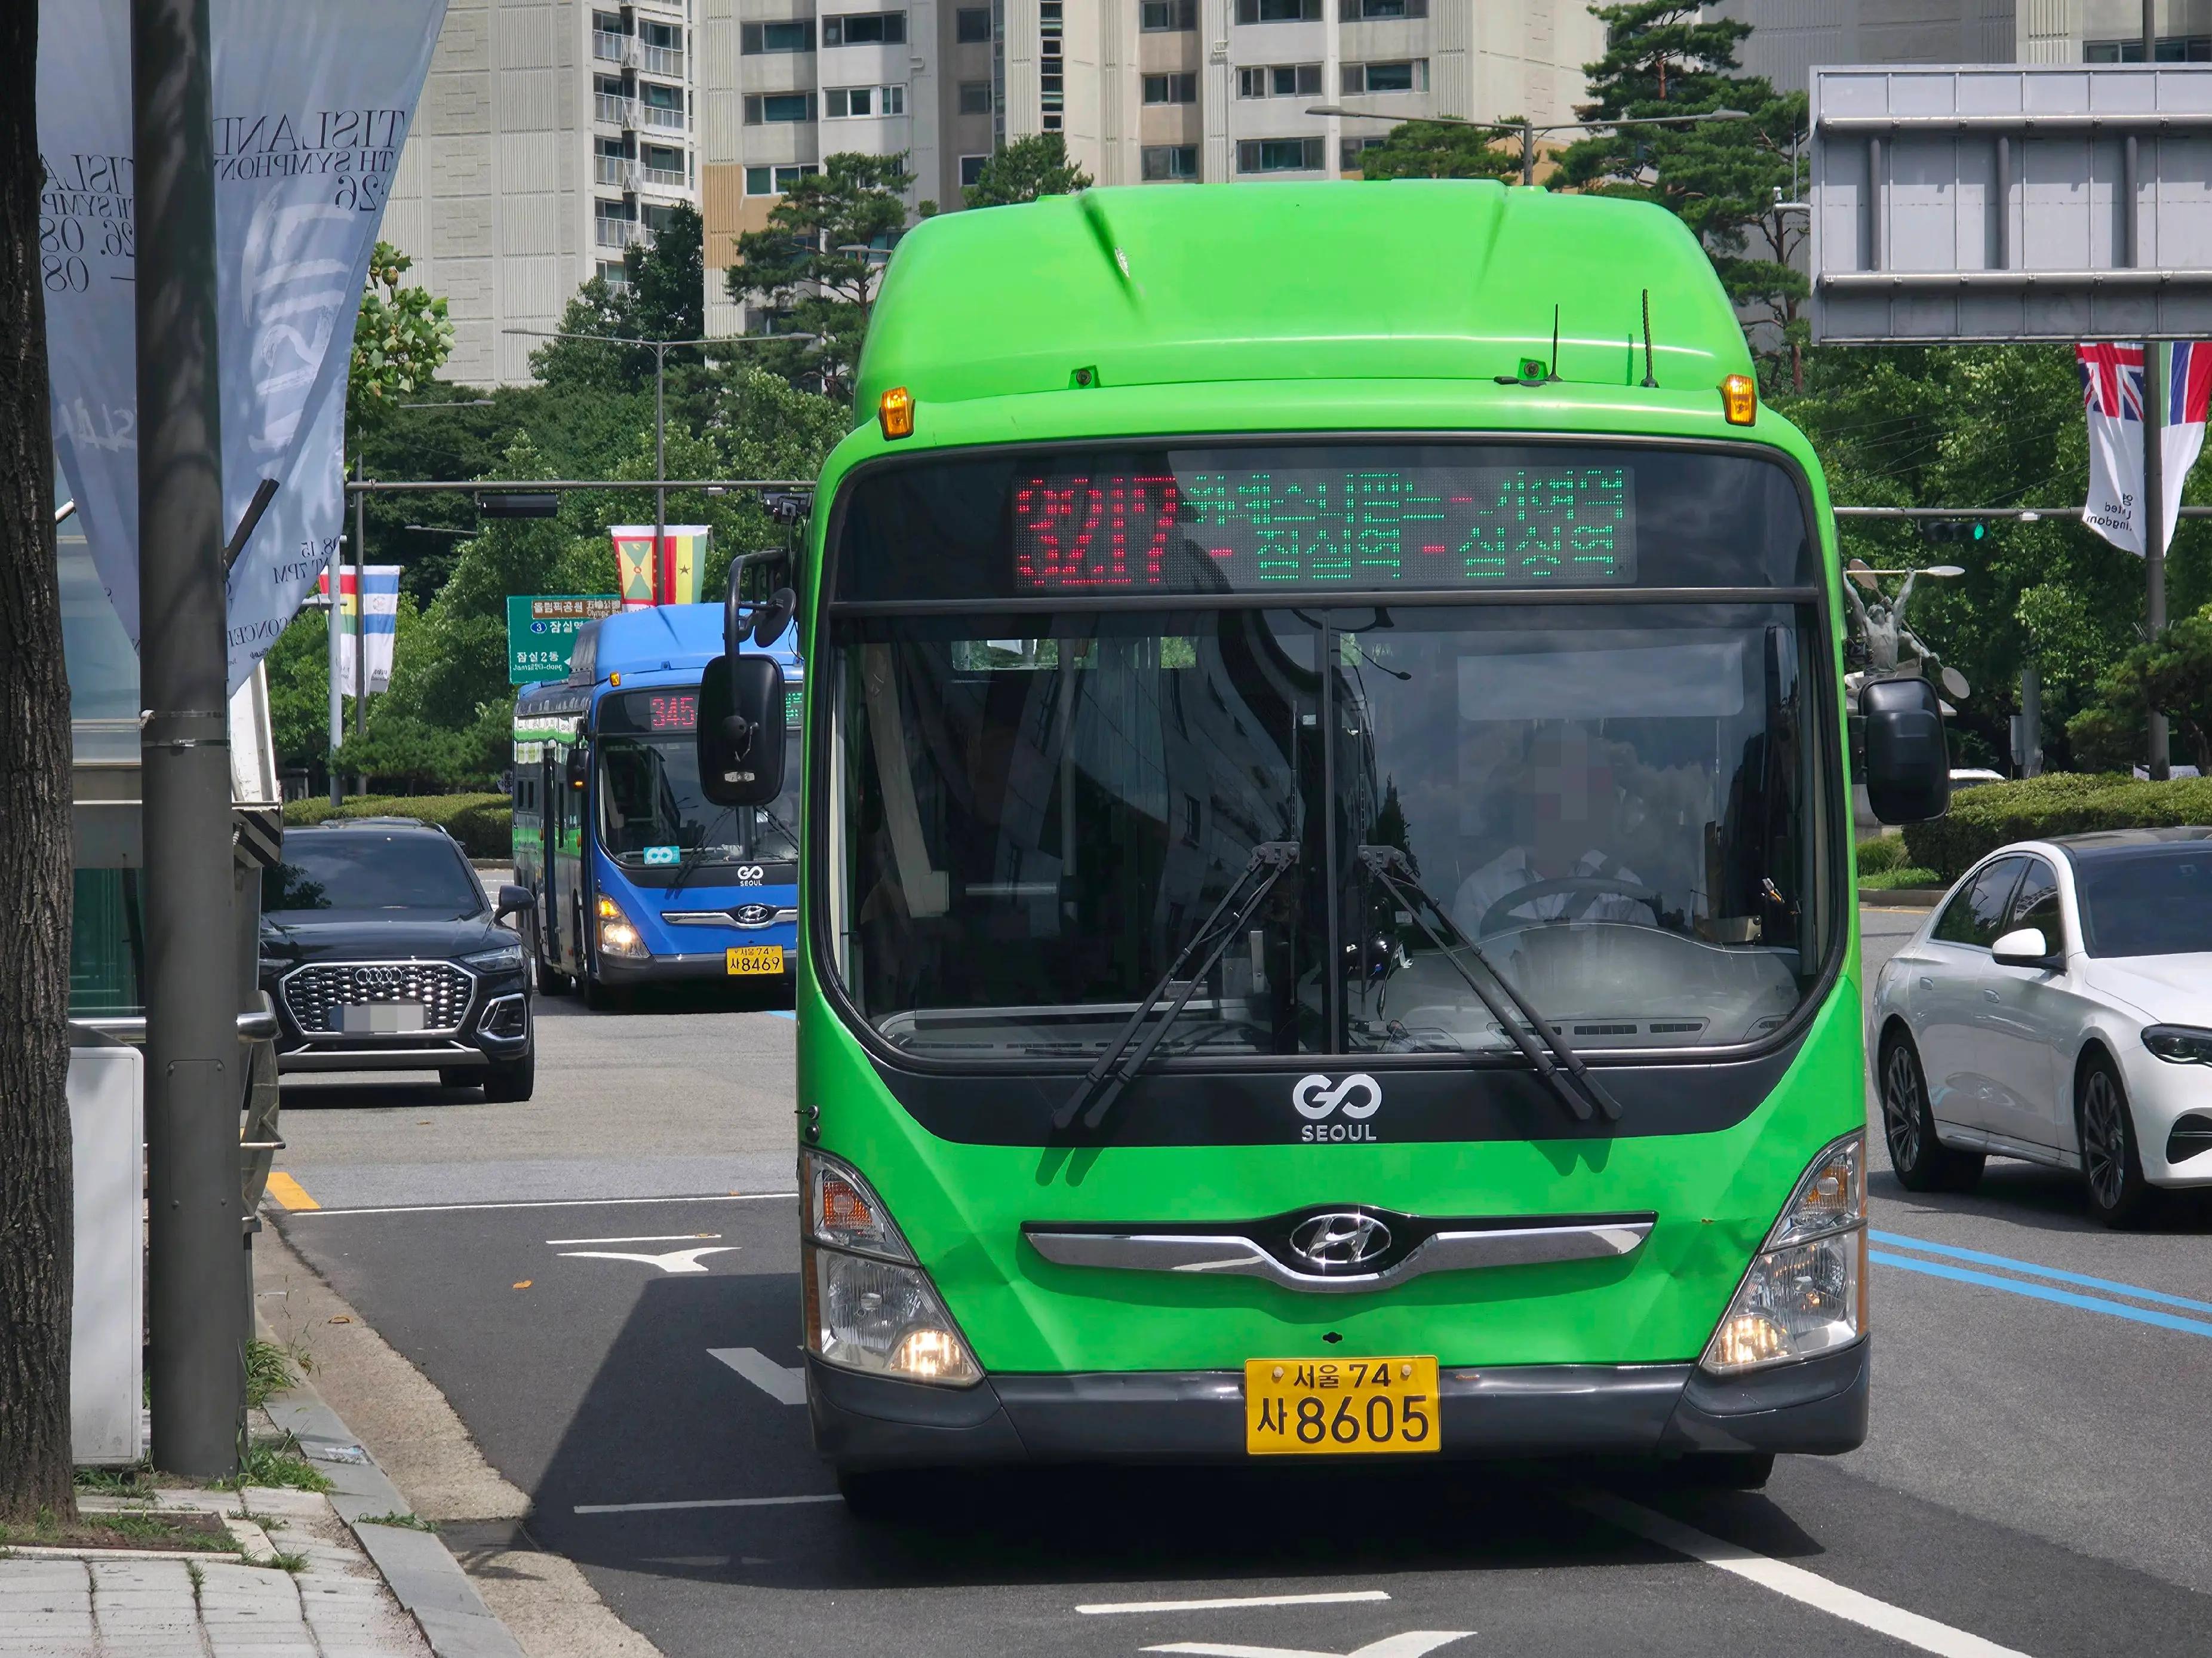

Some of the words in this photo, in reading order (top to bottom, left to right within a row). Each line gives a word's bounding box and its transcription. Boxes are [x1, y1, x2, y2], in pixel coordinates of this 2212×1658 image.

[1256, 528, 1402, 581] 잠실역
[756, 947, 769, 956] 74
[1301, 1123, 1377, 1143] SEOUL
[1293, 1364, 1340, 1389] 서울
[1348, 1363, 1391, 1389] 74
